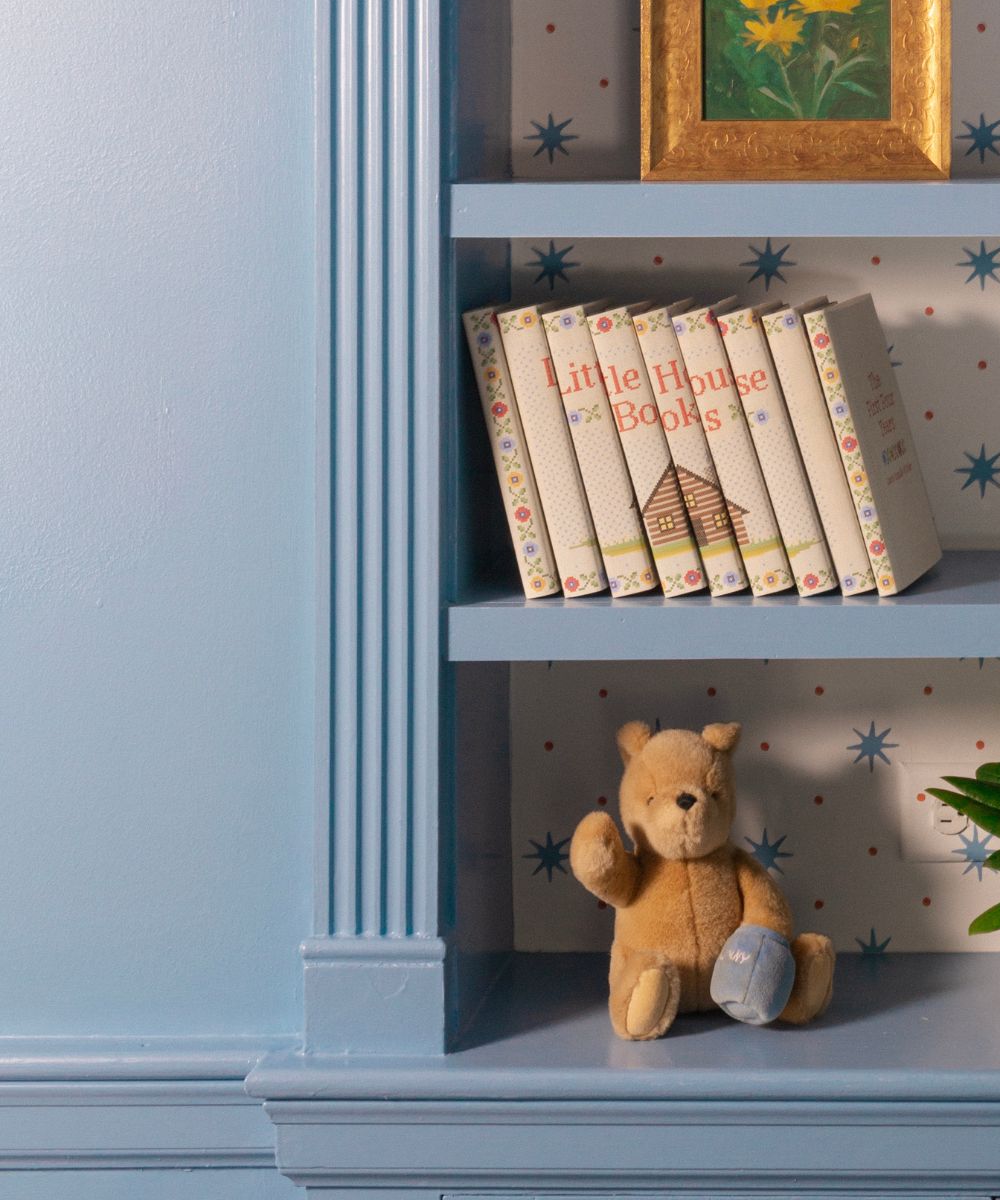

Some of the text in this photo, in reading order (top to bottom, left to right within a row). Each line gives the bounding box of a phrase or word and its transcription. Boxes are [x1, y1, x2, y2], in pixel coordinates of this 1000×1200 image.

[540, 357, 769, 397] Little House
[613, 397, 722, 433] Books
